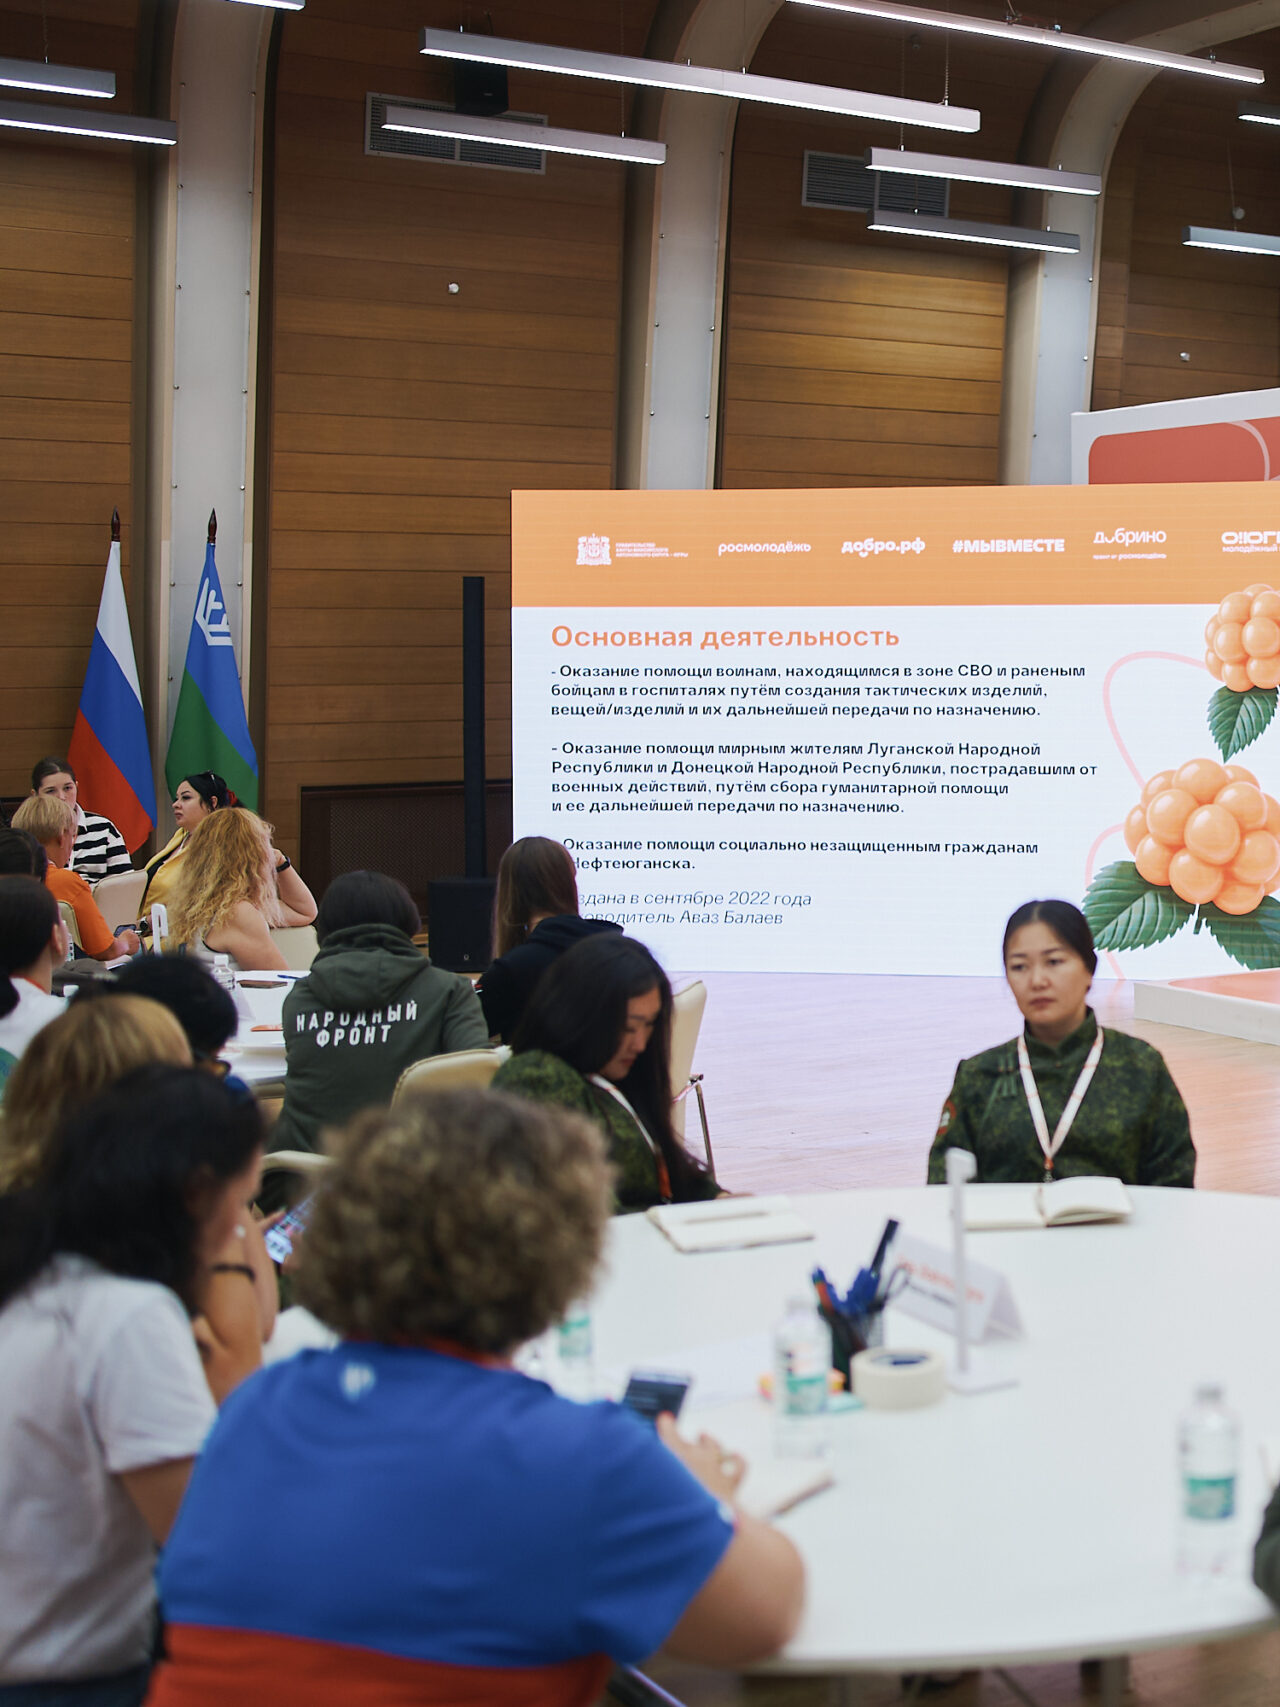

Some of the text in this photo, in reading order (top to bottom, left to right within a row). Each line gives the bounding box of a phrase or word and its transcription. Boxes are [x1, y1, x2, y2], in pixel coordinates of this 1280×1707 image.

[718, 540, 812, 557] росмолодёжь
[841, 537, 926, 557] добро.рф
[952, 538, 1065, 553] #МЫВМЕСТЕ
[551, 624, 900, 652] Основная деятельность
[559, 664, 640, 677] Оказание
[644, 667, 712, 679] помощи
[716, 667, 781, 678] воинам,
[785, 667, 900, 679] находящимся
[903, 667, 913, 677] в
[916, 667, 954, 677] зоне
[957, 664, 993, 677] СВО
[997, 667, 1007, 677] и
[1011, 667, 1085, 680] раненым
[551, 683, 1047, 699] бойцам в госпиталях путём создания тактических изделий,
[551, 703, 1040, 719] вещей/изделий и их дальнейшей передачи по назначению.
[562, 741, 642, 754] Оказание
[646, 744, 715, 756] помощи
[718, 745, 786, 757] мирным
[790, 745, 863, 755] жителям
[867, 742, 954, 758] Луганской
[958, 742, 1041, 758] Народной
[552, 760, 1097, 778] Республики и Донецкой Народной Республики, пострадавшим от
[551, 780, 1009, 797] военных действий, путём сбора гуманитарной помощи
[552, 799, 904, 815] и ее дальнейшей передачи по назначению.
[563, 838, 1038, 856] Оказание помощи социально незащищенным гражданам
[578, 891, 812, 908] здана в сентябре 2022 года
[679, 910, 719, 924] Аваз
[723, 910, 783, 925] Балаев
[296, 1000, 418, 1032] НАРОДНЫЙ
[316, 1024, 392, 1048] ФРОНТ
